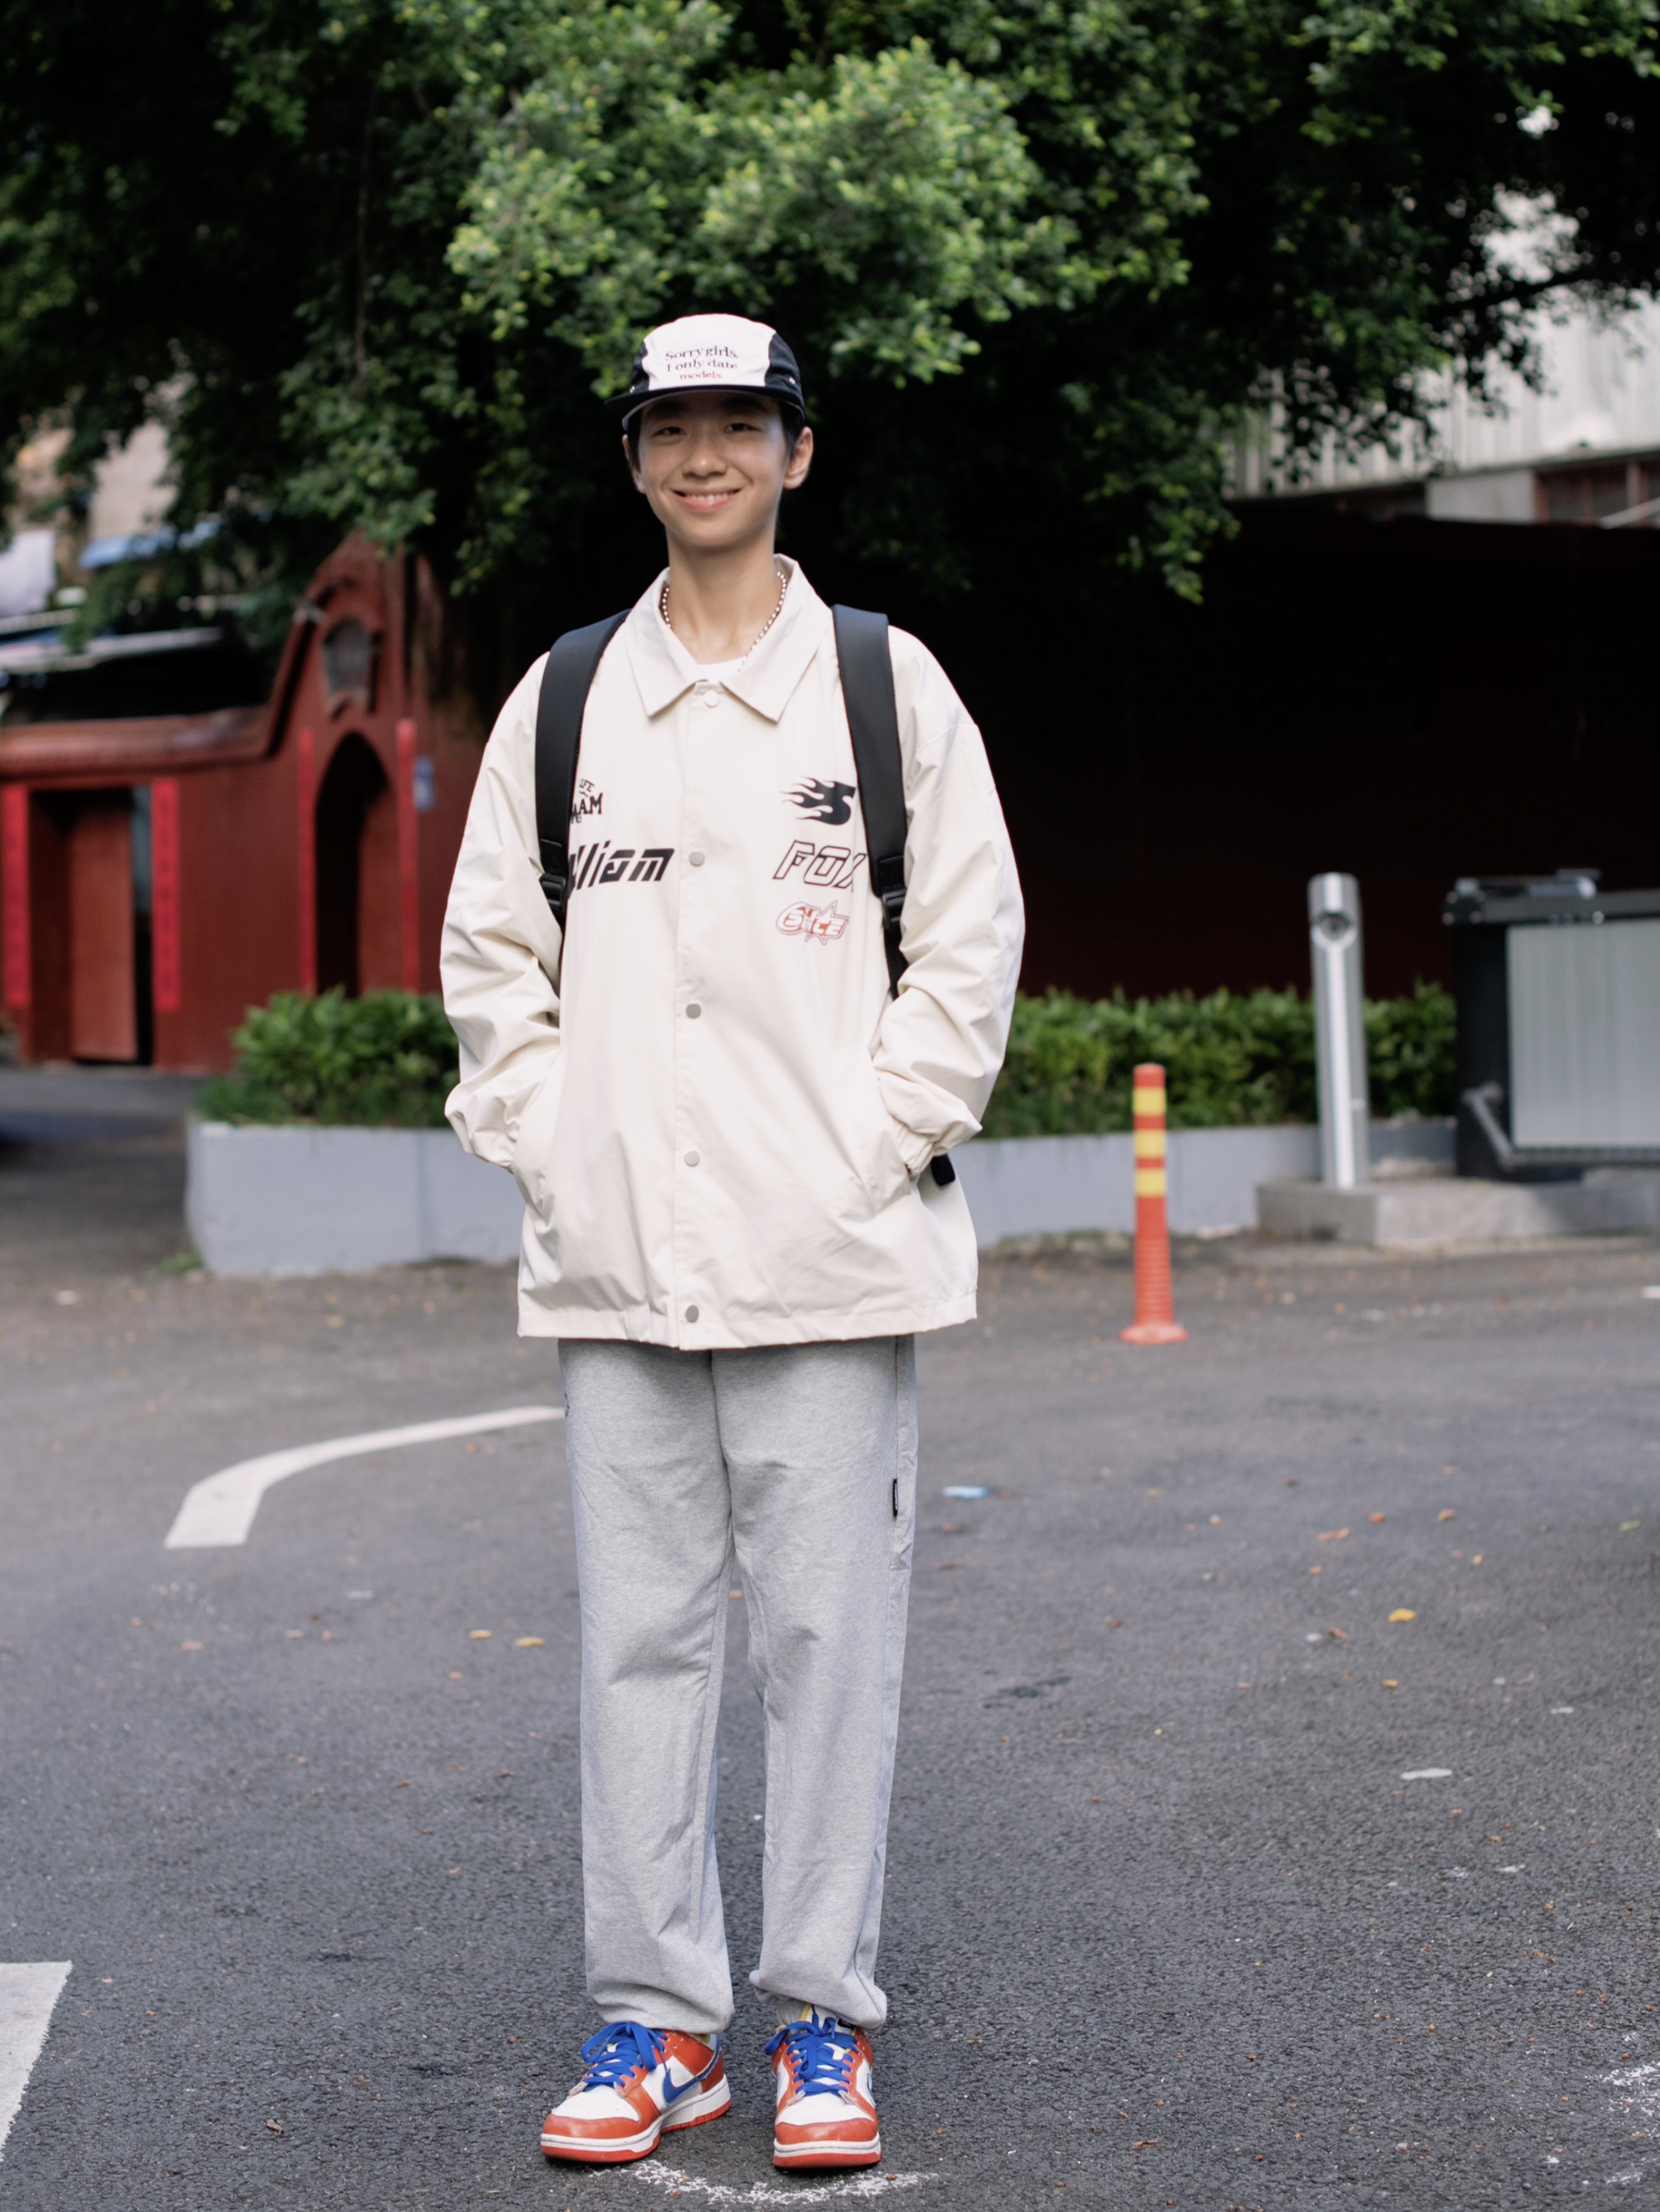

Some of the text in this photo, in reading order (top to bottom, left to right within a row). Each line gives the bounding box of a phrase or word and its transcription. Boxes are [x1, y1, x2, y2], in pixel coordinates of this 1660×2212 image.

[666, 348, 704, 361] Sorry
[667, 360, 737, 372] I only date
